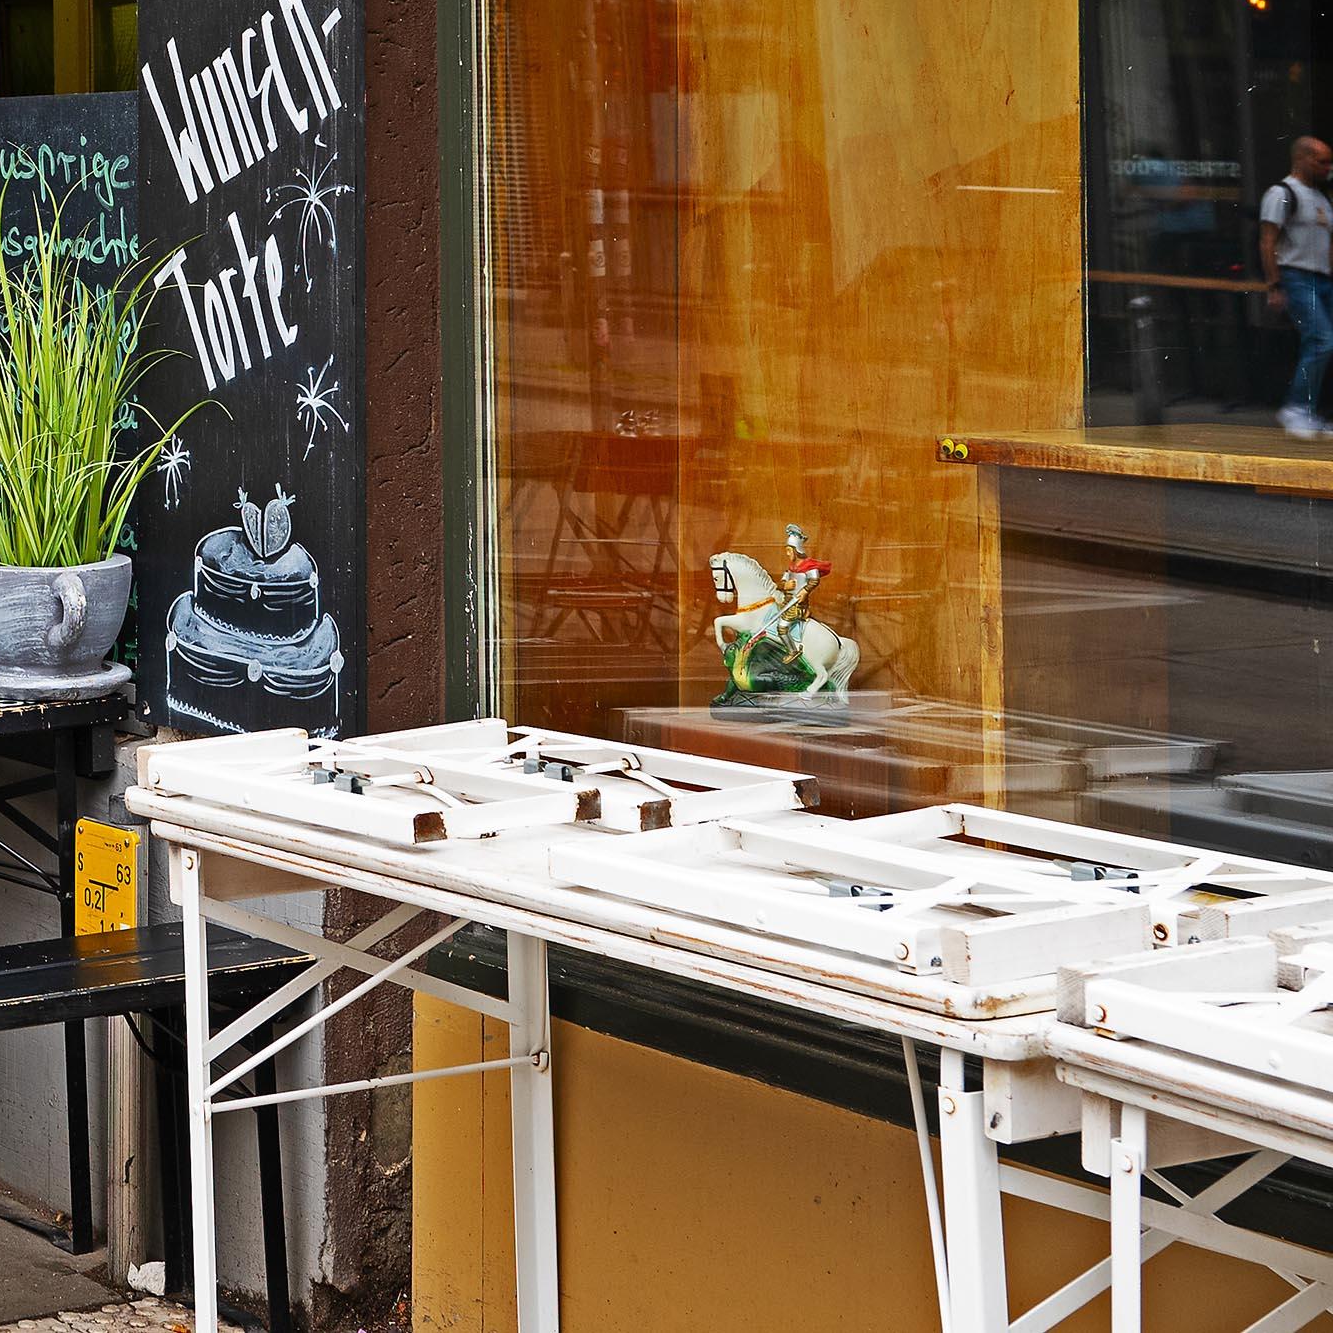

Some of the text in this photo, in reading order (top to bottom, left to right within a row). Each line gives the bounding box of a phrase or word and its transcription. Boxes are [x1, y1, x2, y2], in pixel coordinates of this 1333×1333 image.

[78, 852, 84, 872] S
[116, 863, 132, 886] 63
[84, 887, 102, 911] 0,2
